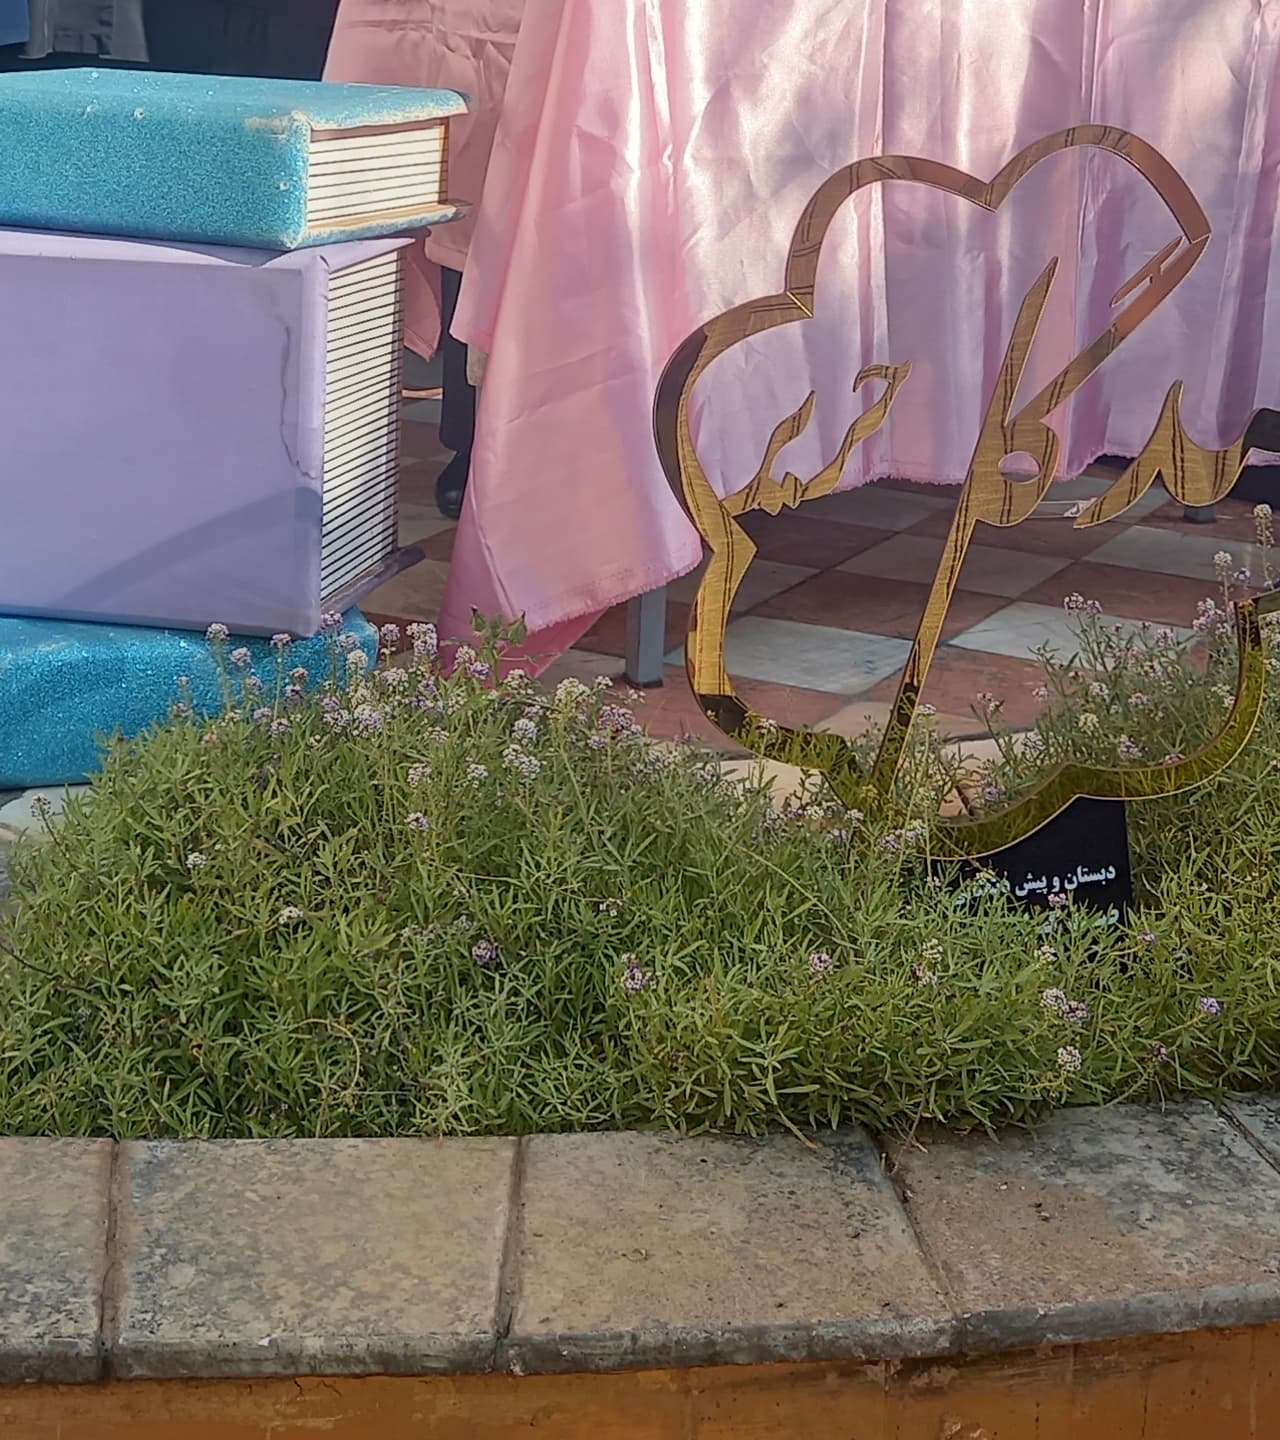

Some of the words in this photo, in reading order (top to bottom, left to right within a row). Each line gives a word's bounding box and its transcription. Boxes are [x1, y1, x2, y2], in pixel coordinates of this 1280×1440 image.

[1015, 873, 1047, 897] پیش
[1052, 877, 1061, 893] و
[1064, 864, 1116, 890] دبستان
